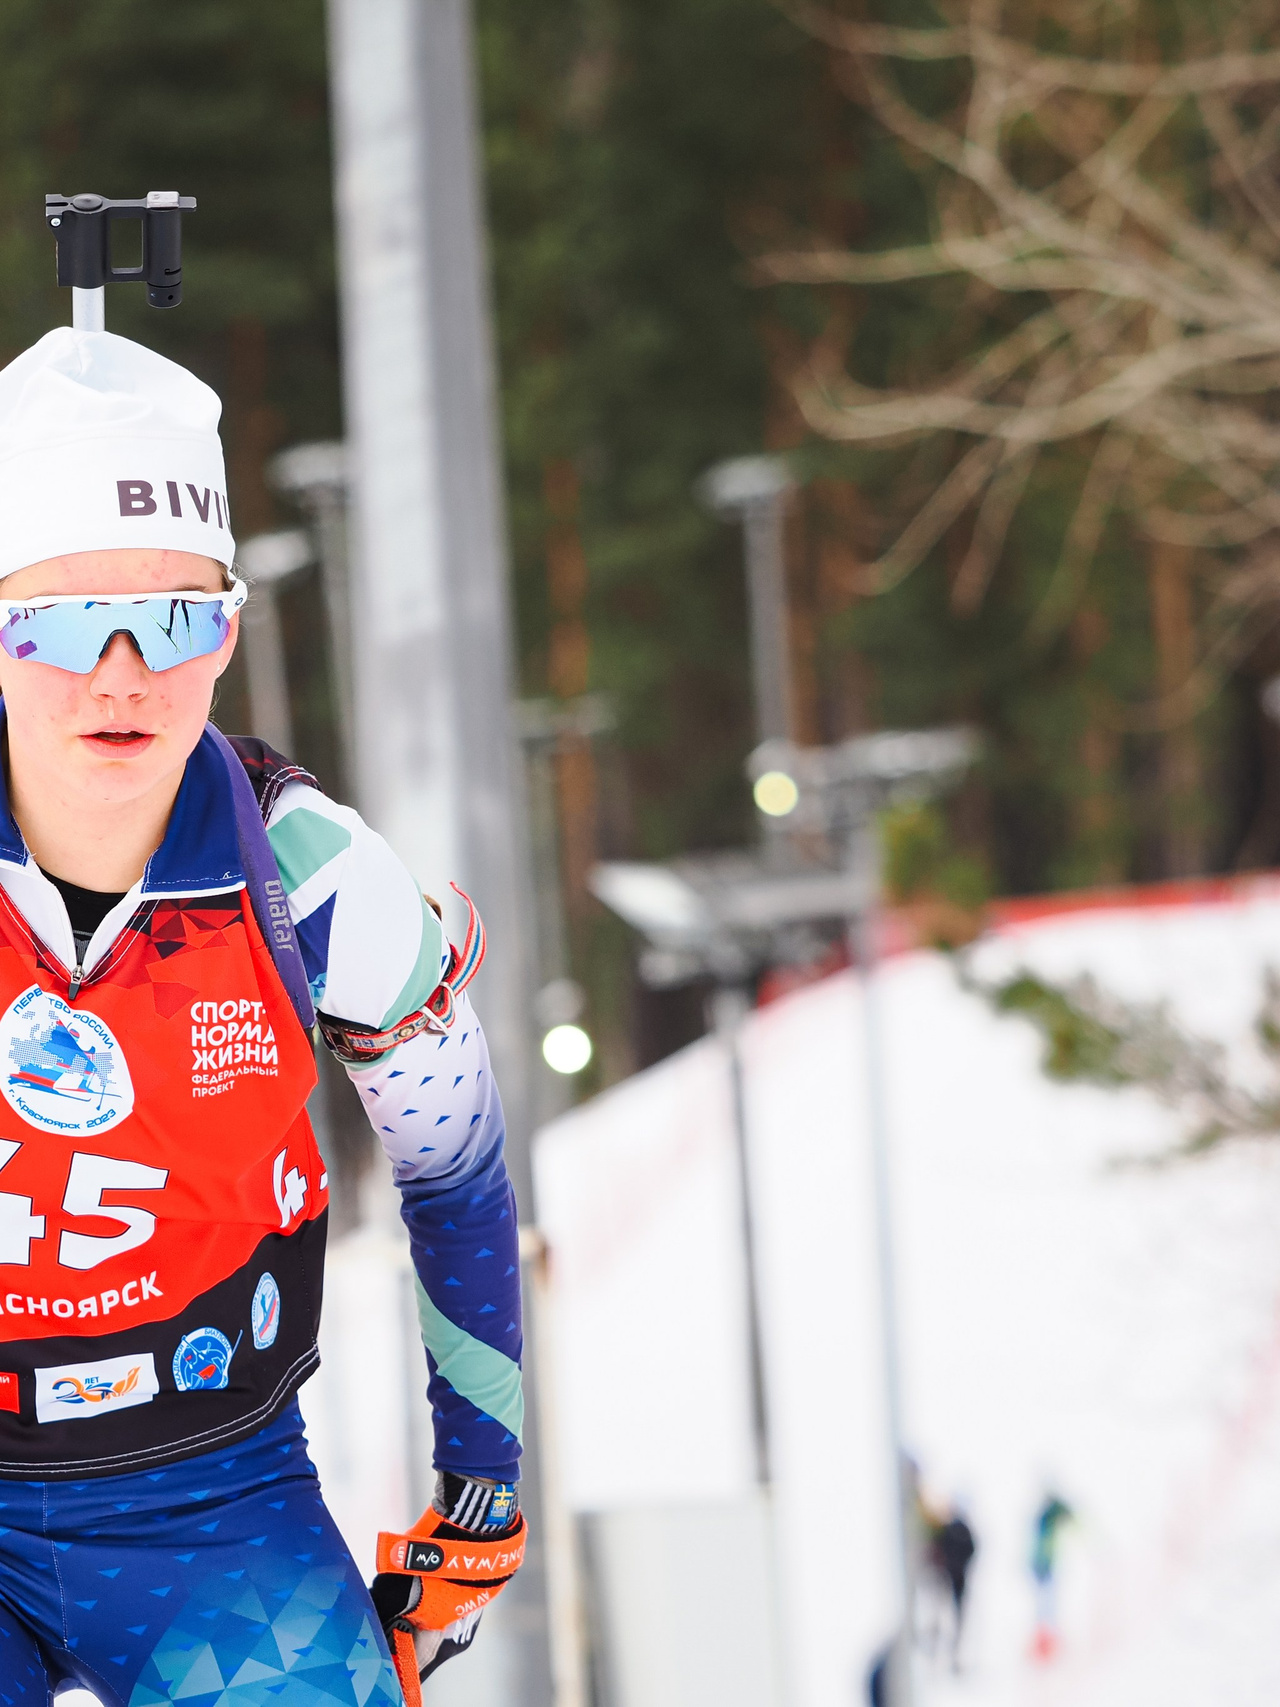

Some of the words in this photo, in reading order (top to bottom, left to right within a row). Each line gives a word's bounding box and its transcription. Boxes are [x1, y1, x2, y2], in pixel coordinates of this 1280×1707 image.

[191, 1021, 276, 1047] НОРМА
[191, 1042, 279, 1070] ЖИЗНИ
[191, 1065, 278, 1085] ФЕДЕРАЛЬНЫЙ
[192, 1080, 235, 1098] ПРОЕКТ
[15, 1097, 81, 1130] Красноярск
[86, 1108, 117, 1129] 2023
[84, 1376, 99, 1385] ЛЕТ
[455, 1590, 490, 1617] AVWC
